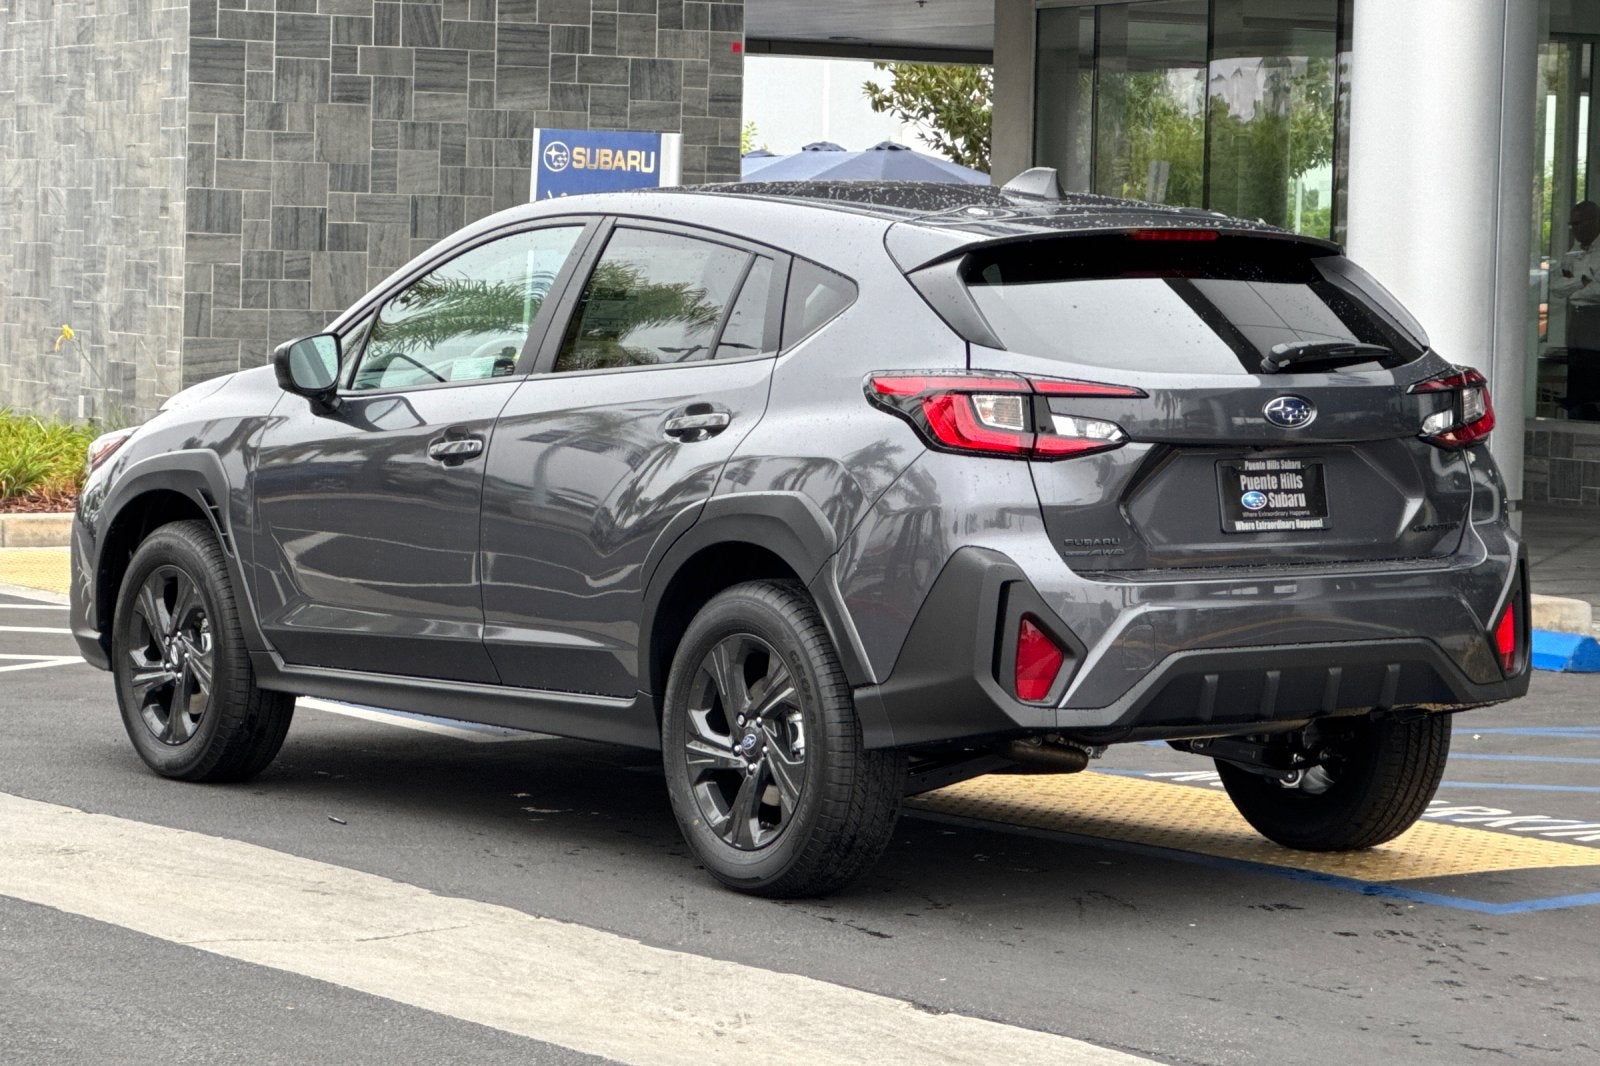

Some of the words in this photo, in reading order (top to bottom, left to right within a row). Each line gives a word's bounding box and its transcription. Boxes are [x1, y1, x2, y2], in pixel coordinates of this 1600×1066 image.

[572, 147, 655, 173] SUBARU
[1240, 474, 1278, 490] Puente
[1280, 472, 1303, 490] Hills
[1268, 492, 1306, 508] Subaru
[1063, 537, 1121, 547] SUBARU
